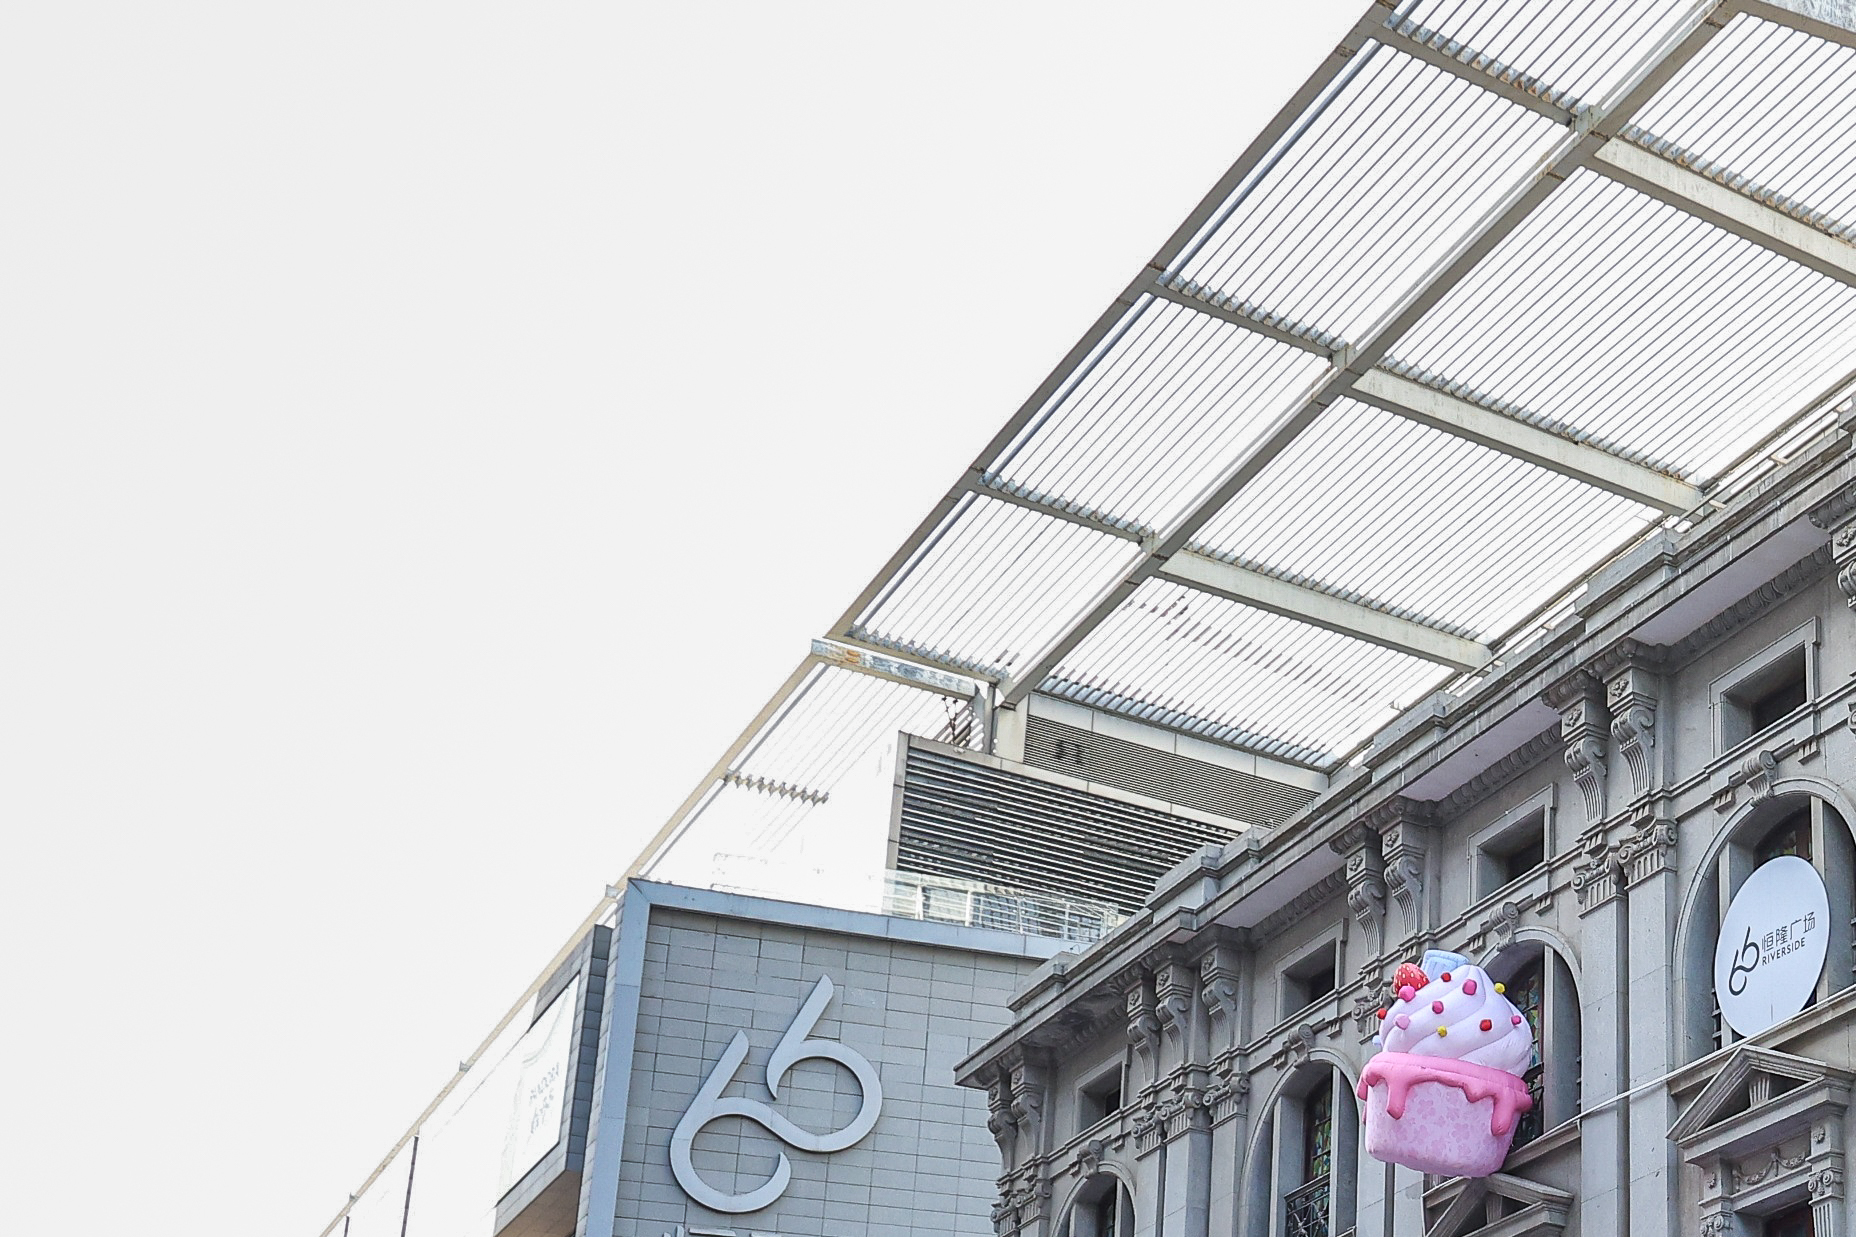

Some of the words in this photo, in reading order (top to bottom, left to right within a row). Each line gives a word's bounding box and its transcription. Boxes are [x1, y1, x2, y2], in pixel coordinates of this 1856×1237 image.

[1761, 910, 1816, 953] 恒隆广场
[1761, 936, 1806, 967] RIVERSIDE
